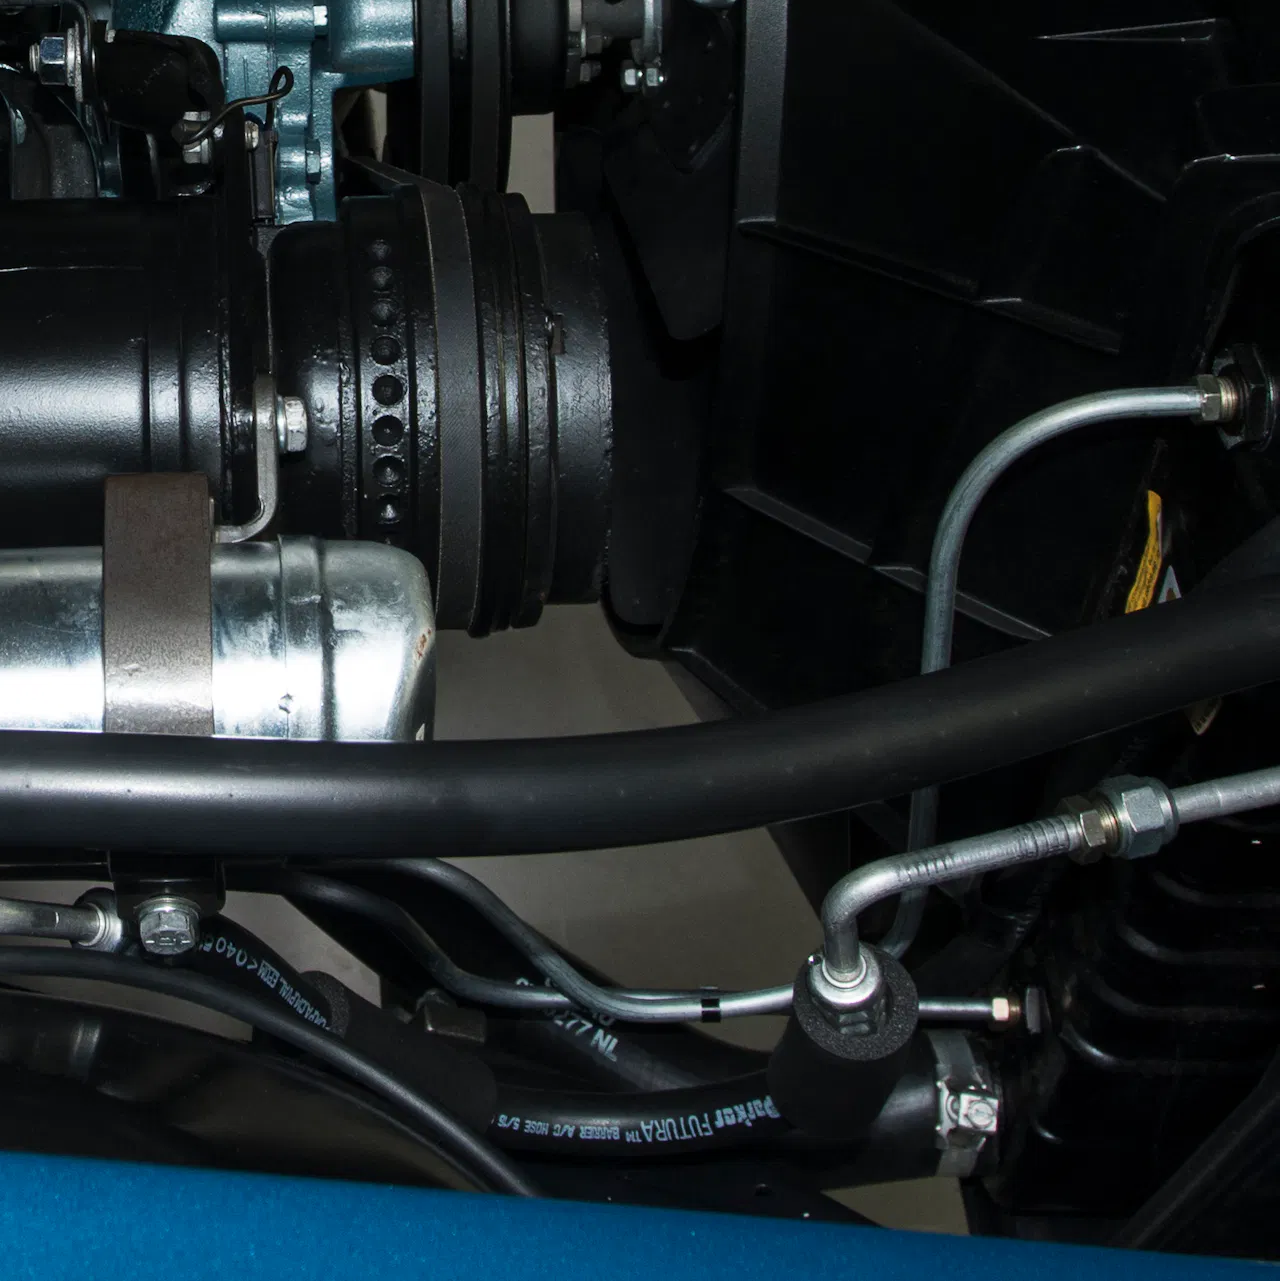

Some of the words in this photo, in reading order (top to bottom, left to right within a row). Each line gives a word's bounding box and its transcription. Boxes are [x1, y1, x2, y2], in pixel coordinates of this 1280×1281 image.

[714, 1095, 781, 1128] Parker
[524, 1120, 549, 1136] HOSE
[552, 1124, 576, 1139] A/C
[579, 1126, 620, 1140] BARRIER
